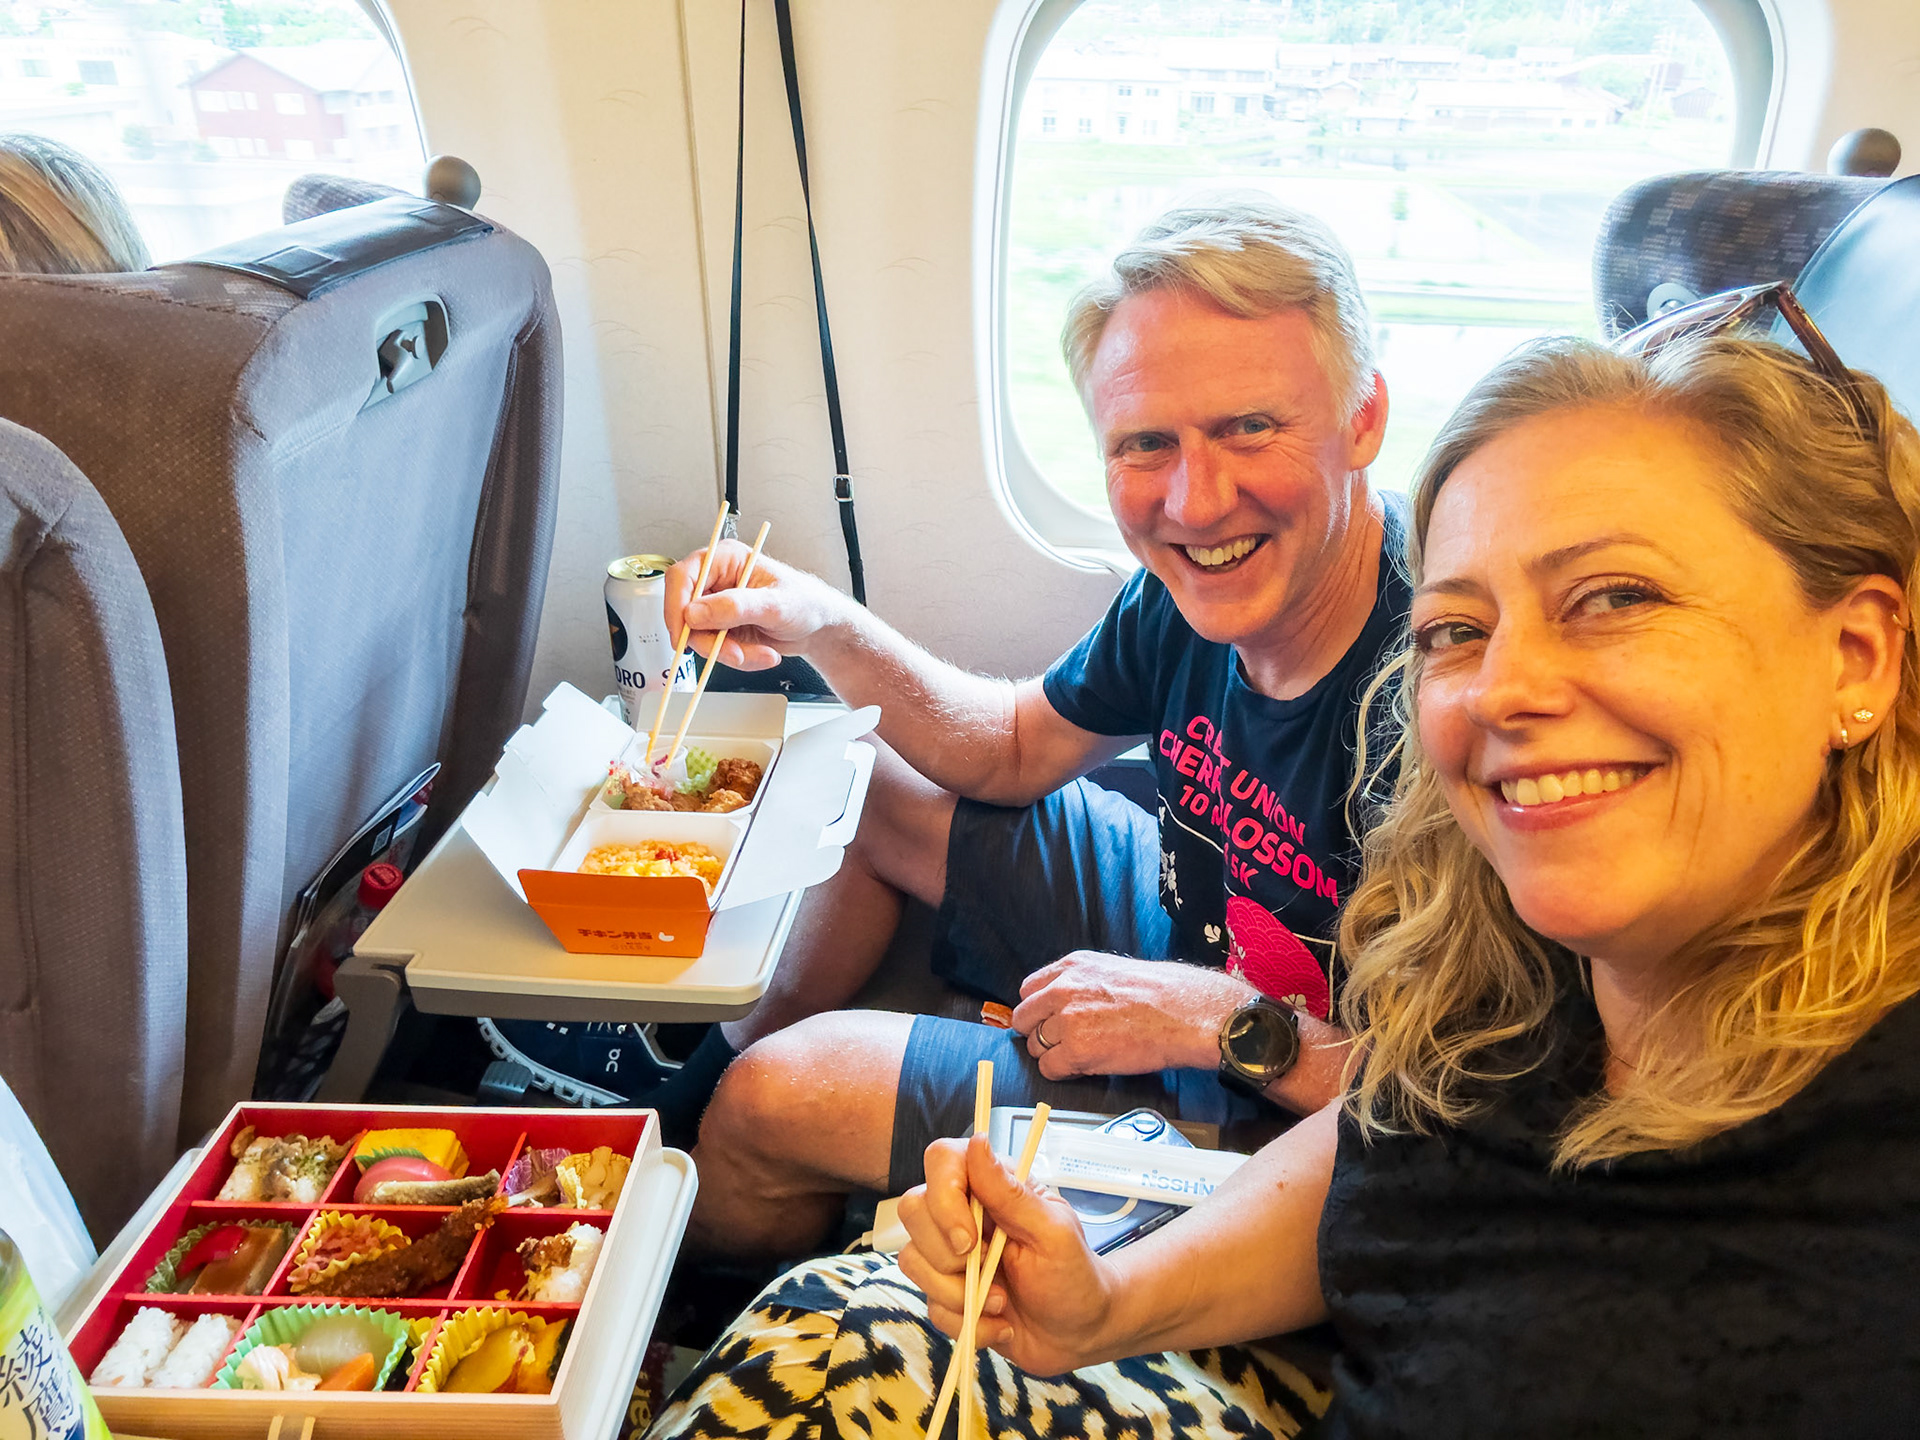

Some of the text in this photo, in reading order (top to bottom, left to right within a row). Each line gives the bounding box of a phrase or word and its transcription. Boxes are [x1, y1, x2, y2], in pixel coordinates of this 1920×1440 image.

[1179, 785, 1260, 891] 10 5K
[1221, 801, 1339, 907] LOSSOM
[1229, 769, 1306, 846] UNION
